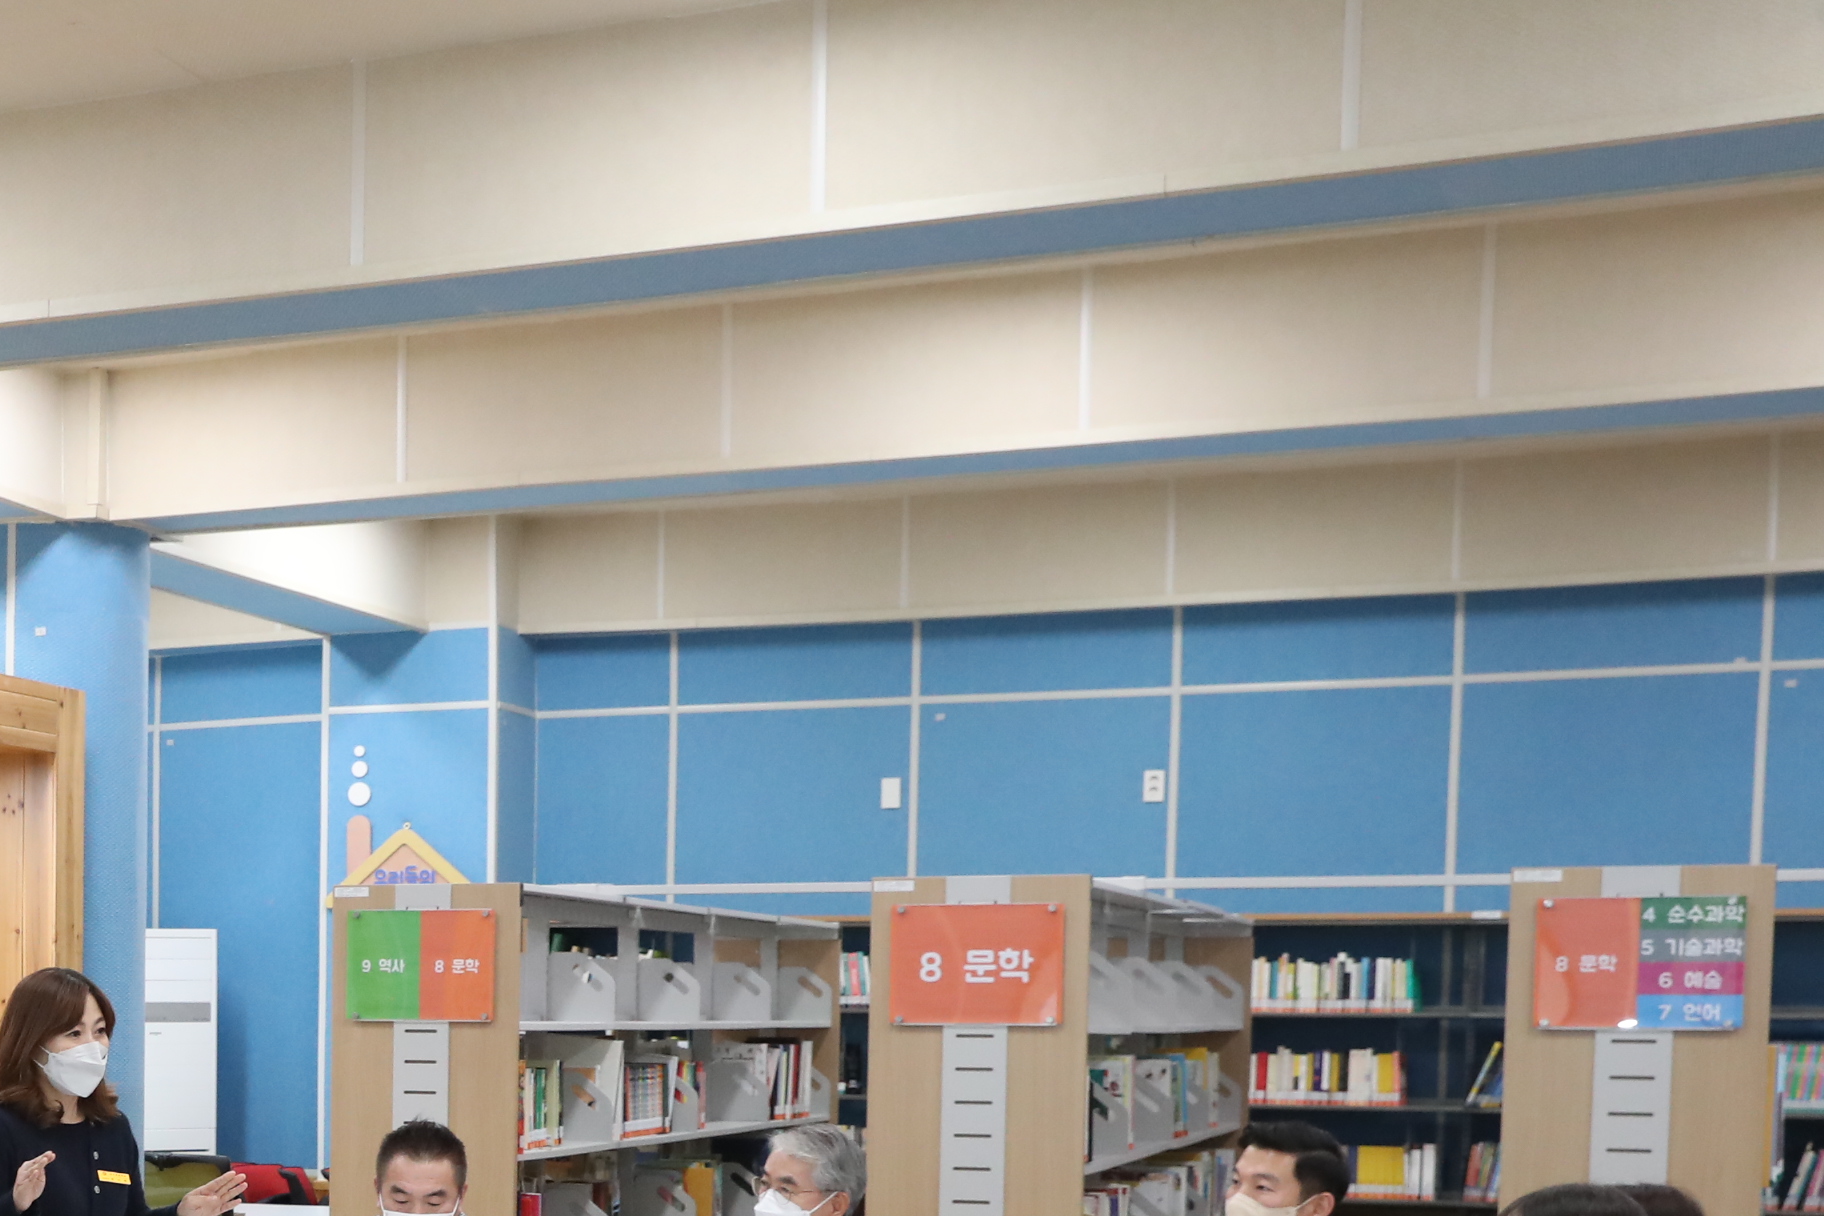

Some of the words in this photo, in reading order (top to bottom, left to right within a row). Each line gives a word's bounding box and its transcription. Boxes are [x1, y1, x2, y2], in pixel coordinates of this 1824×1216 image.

[1642, 906, 1656, 923] 4
[1667, 904, 1745, 924] 순수과학
[1641, 938, 1654, 956] 5
[1666, 938, 1743, 957] 기술과학
[361, 958, 372, 974] 9
[378, 958, 406, 974] 역사
[434, 958, 445, 974] 8
[451, 957, 481, 974] 문학
[919, 951, 943, 983] 8
[963, 947, 1035, 984] 문학
[1555, 956, 1569, 973] 8
[1579, 954, 1618, 973] 문학
[1658, 971, 1673, 989] 6
[1684, 970, 1723, 990] 예술
[1658, 1004, 1672, 1021] 7
[1683, 1002, 1722, 1021] 언어
